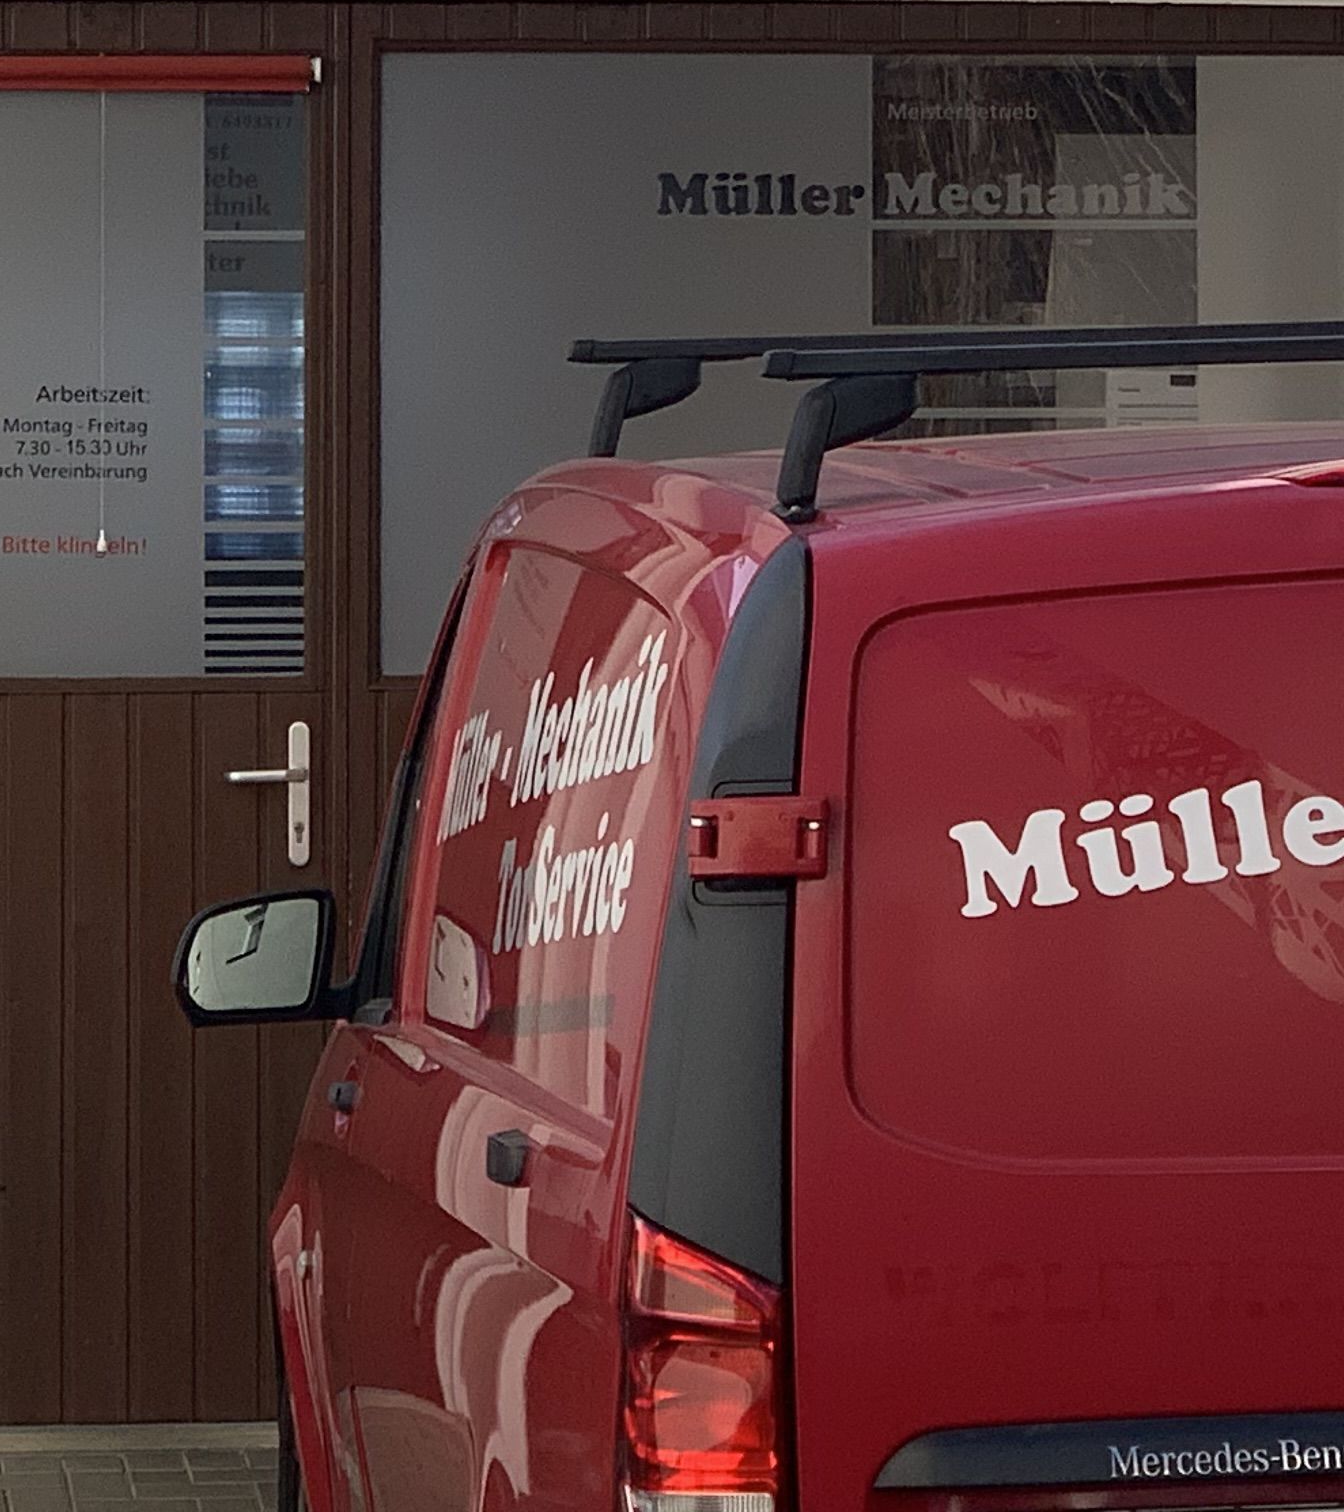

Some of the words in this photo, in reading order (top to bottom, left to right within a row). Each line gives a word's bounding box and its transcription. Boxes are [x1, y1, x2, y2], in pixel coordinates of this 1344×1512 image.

[887, 102, 1038, 121] Meisterbetrieb
[657, 172, 865, 216] Müller
[883, 171, 1191, 216] Mechanik
[35, 385, 150, 404] Arbeitszeit:
[3, 418, 72, 437] Montag
[88, 418, 148, 437] Freitag
[16, 440, 50, 456] 7.30
[116, 440, 147, 456] Uhr
[28, 463, 148, 482] Vereinbarung
[2, 536, 50, 554] Bitte
[510, 629, 668, 807] Mechanik
